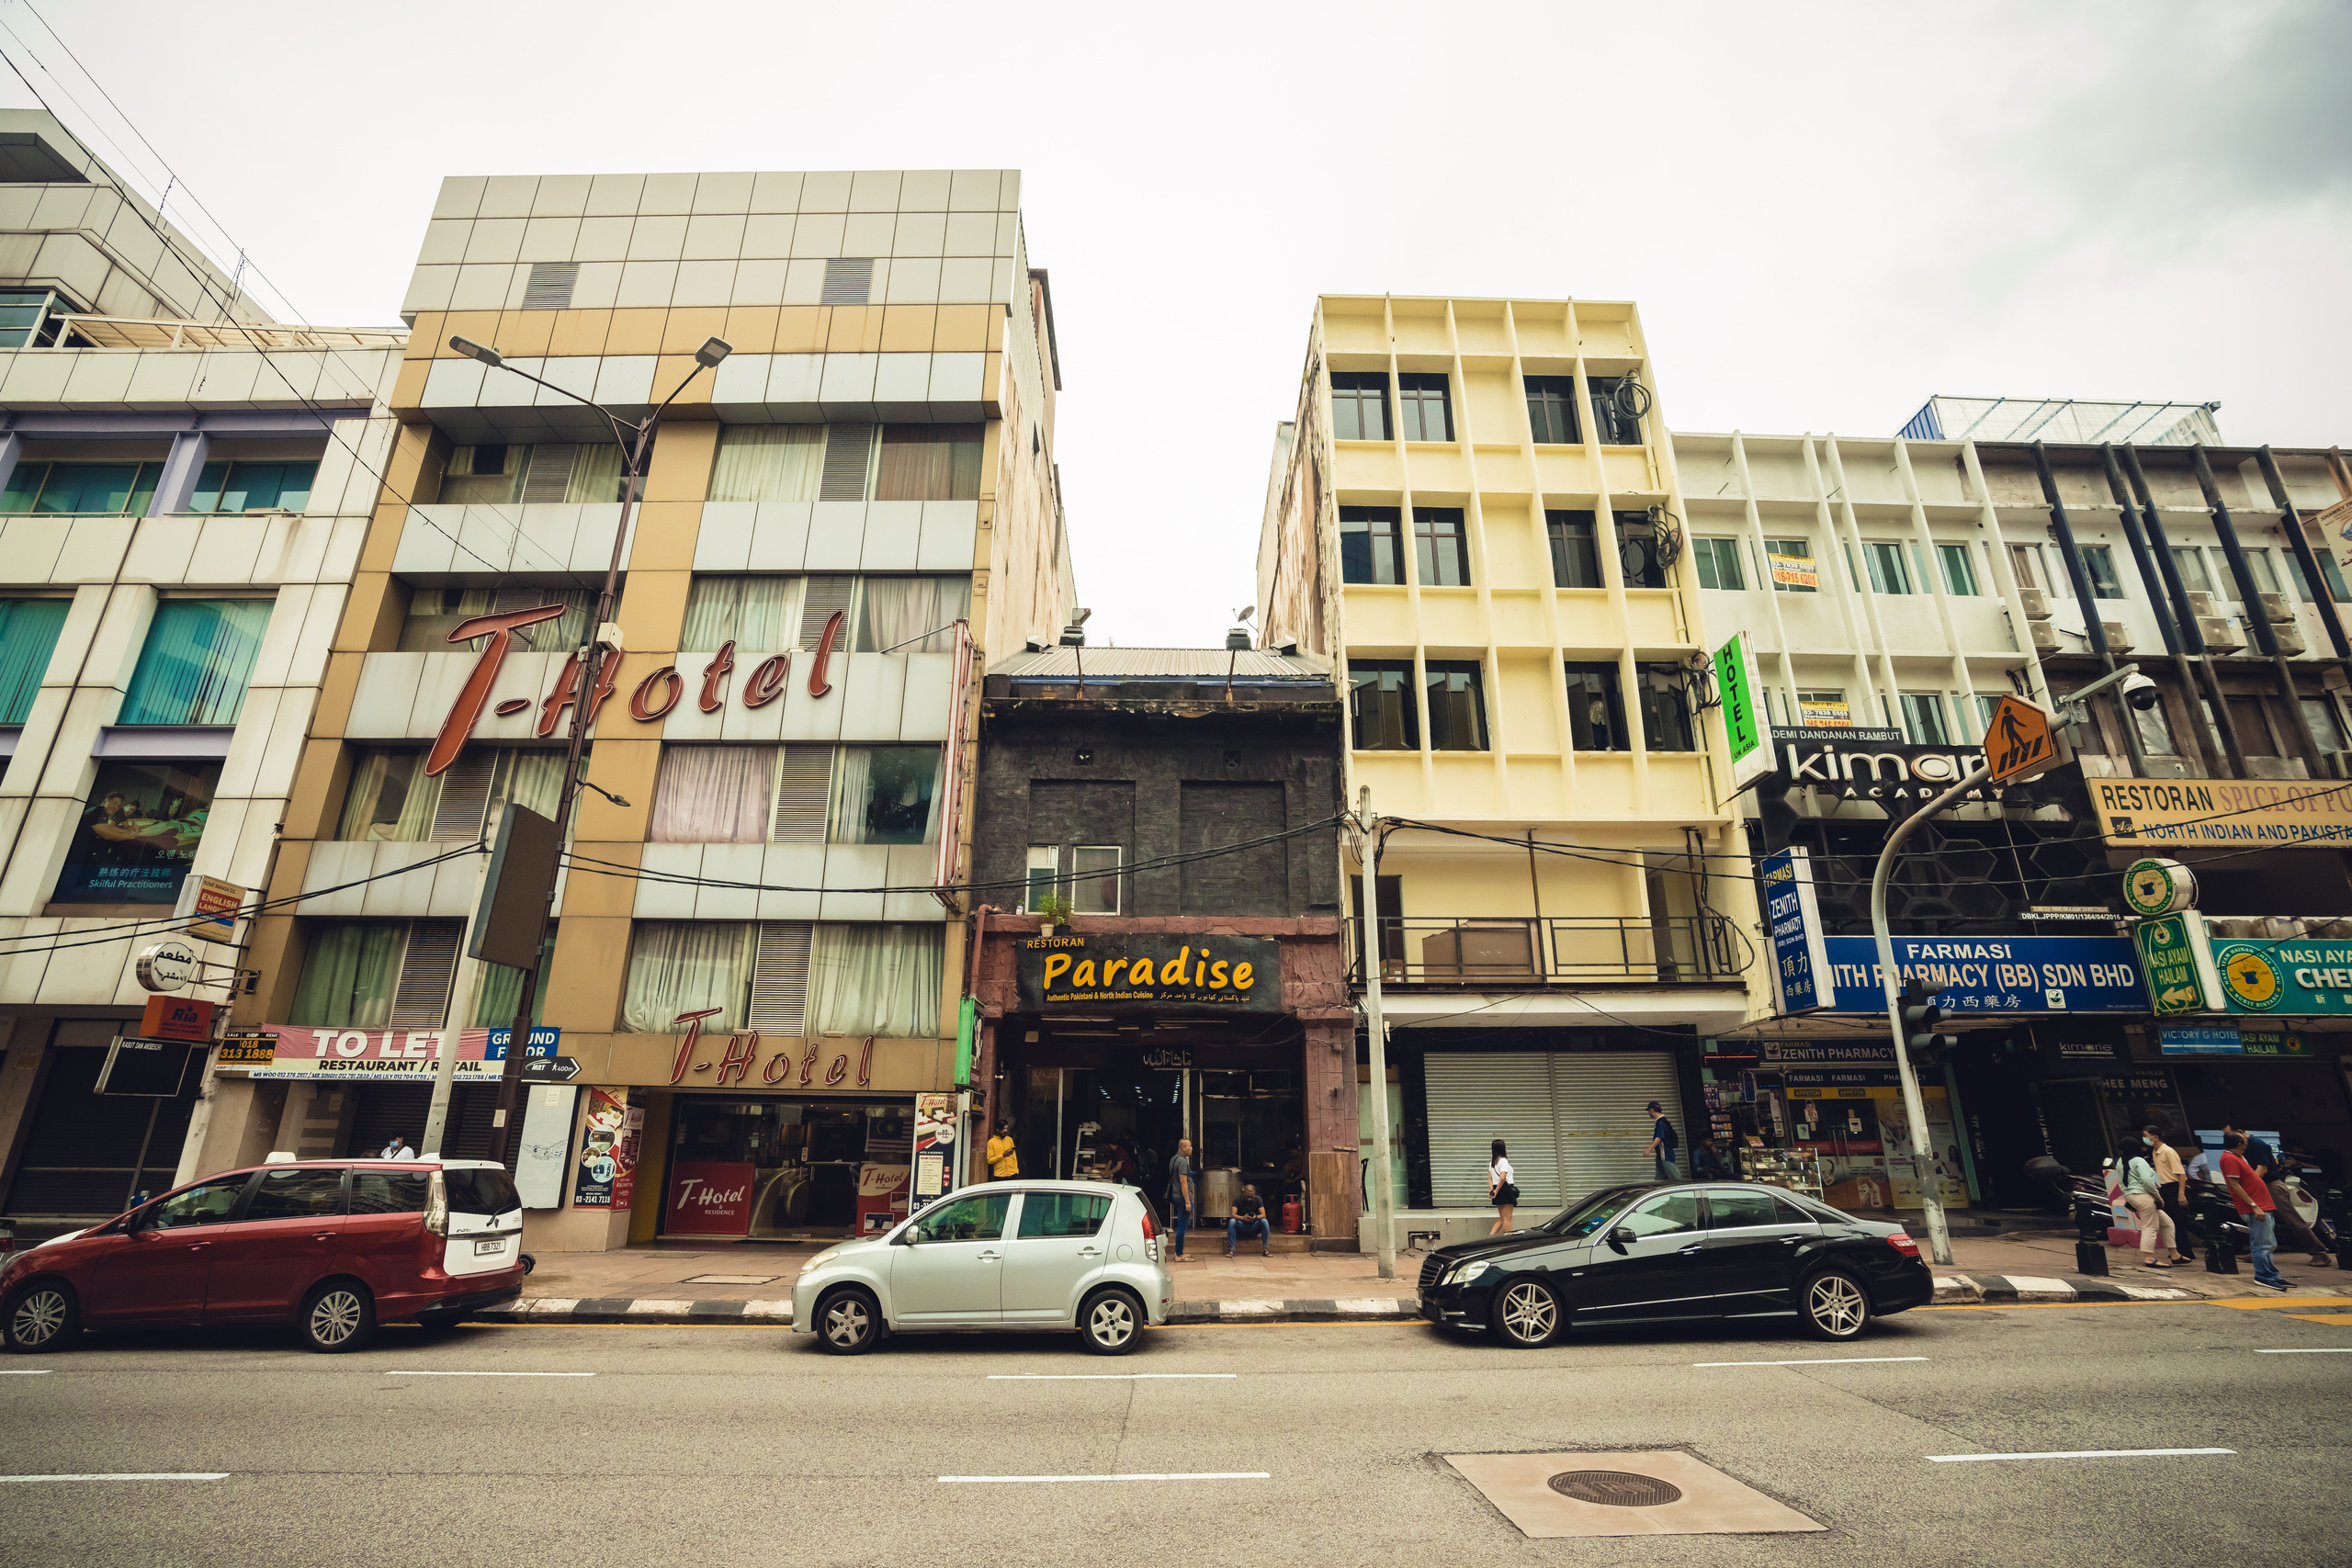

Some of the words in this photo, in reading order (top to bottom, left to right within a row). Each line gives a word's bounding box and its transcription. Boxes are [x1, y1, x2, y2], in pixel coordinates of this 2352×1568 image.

[424, 603, 845, 777] T-Hotel
[1723, 644, 1746, 743] HOTEL
[1800, 730, 1857, 740] DANDANAN
[1859, 731, 1900, 740] RAMBUT
[1734, 749, 1742, 760] UK
[1742, 740, 1755, 754] ASIA
[1786, 743, 2045, 784] kimar
[1844, 787, 2004, 799] ACADMY
[2100, 784, 2215, 811] RESTORAN
[2219, 785, 2286, 812] SPICE
[2288, 785, 2318, 812] OF
[2143, 823, 2196, 839] NORTH
[2200, 824, 2252, 840] INDIAN
[2257, 824, 2289, 840] AND
[97, 867, 173, 878] 熟练的疗法技师
[1764, 863, 1793, 887] FARMASI
[88, 879, 117, 888] Skilful
[117, 879, 174, 888] Practitioners
[201, 893, 238, 908] ENGLISH
[1770, 891, 1799, 919] ZENITH
[1026, 938, 1085, 949] RESTORAN
[1786, 935, 1795, 945] SDN
[1795, 933, 1804, 943] BHD
[154, 951, 191, 964] مطعم
[1906, 943, 2012, 959] FARMASI
[2147, 950, 2167, 968] NASI
[2167, 947, 2189, 965] AYAM
[2279, 950, 2323, 963] NASI
[1043, 945, 1255, 990] Paradise
[1781, 951, 1808, 978] 頂力
[1872, 964, 1988, 987] PARMACY
[1996, 964, 2039, 993] (BB)
[2044, 964, 2087, 987] SDN
[2092, 964, 2134, 987] BHD
[2157, 965, 2188, 986] HAILAM
[2295, 968, 2352, 988] CHE
[1785, 977, 1812, 998] 西藥房
[1070, 992, 1093, 1000] Pakistani
[1100, 991, 1114, 999] North
[2234, 993, 2254, 1007] BUKIT
[2256, 993, 2279, 1008] BINTANG
[171, 1006, 198, 1023] Ria
[492, 1032, 555, 1044] GRUND
[2202, 1031, 2211, 1039] G
[2212, 1031, 2240, 1040] HOTEL
[2258, 1033, 2279, 1043] AYAM
[241, 1040, 259, 1048] 018
[312, 1029, 368, 1058] TO
[669, 1007, 874, 1086] T-Hotel
[2059, 1043, 2112, 1051] kimarie
[2247, 1044, 2278, 1054] HAILAM
[220, 1048, 243, 1059] 313
[244, 1048, 274, 1059] 1888
[496, 1046, 546, 1058] FOR
[1781, 1048, 1826, 1059] ZENITH
[1828, 1047, 1896, 1059] PHARMACY
[318, 1060, 417, 1071] RESTAURANT
[419, 1059, 428, 1072] /
[431, 1061, 481, 1071] RAIL
[2132, 1079, 2167, 1089] MENG
[921, 1095, 946, 1109] T-Hotel
[2037, 1107, 2053, 1156] marie
[863, 1168, 905, 1187] T-Hotel
[575, 1195, 582, 1203] 03
[598, 1195, 611, 1203] 7115
[677, 1179, 746, 1210] T-Hotel
[491, 1241, 501, 1250] 7321
